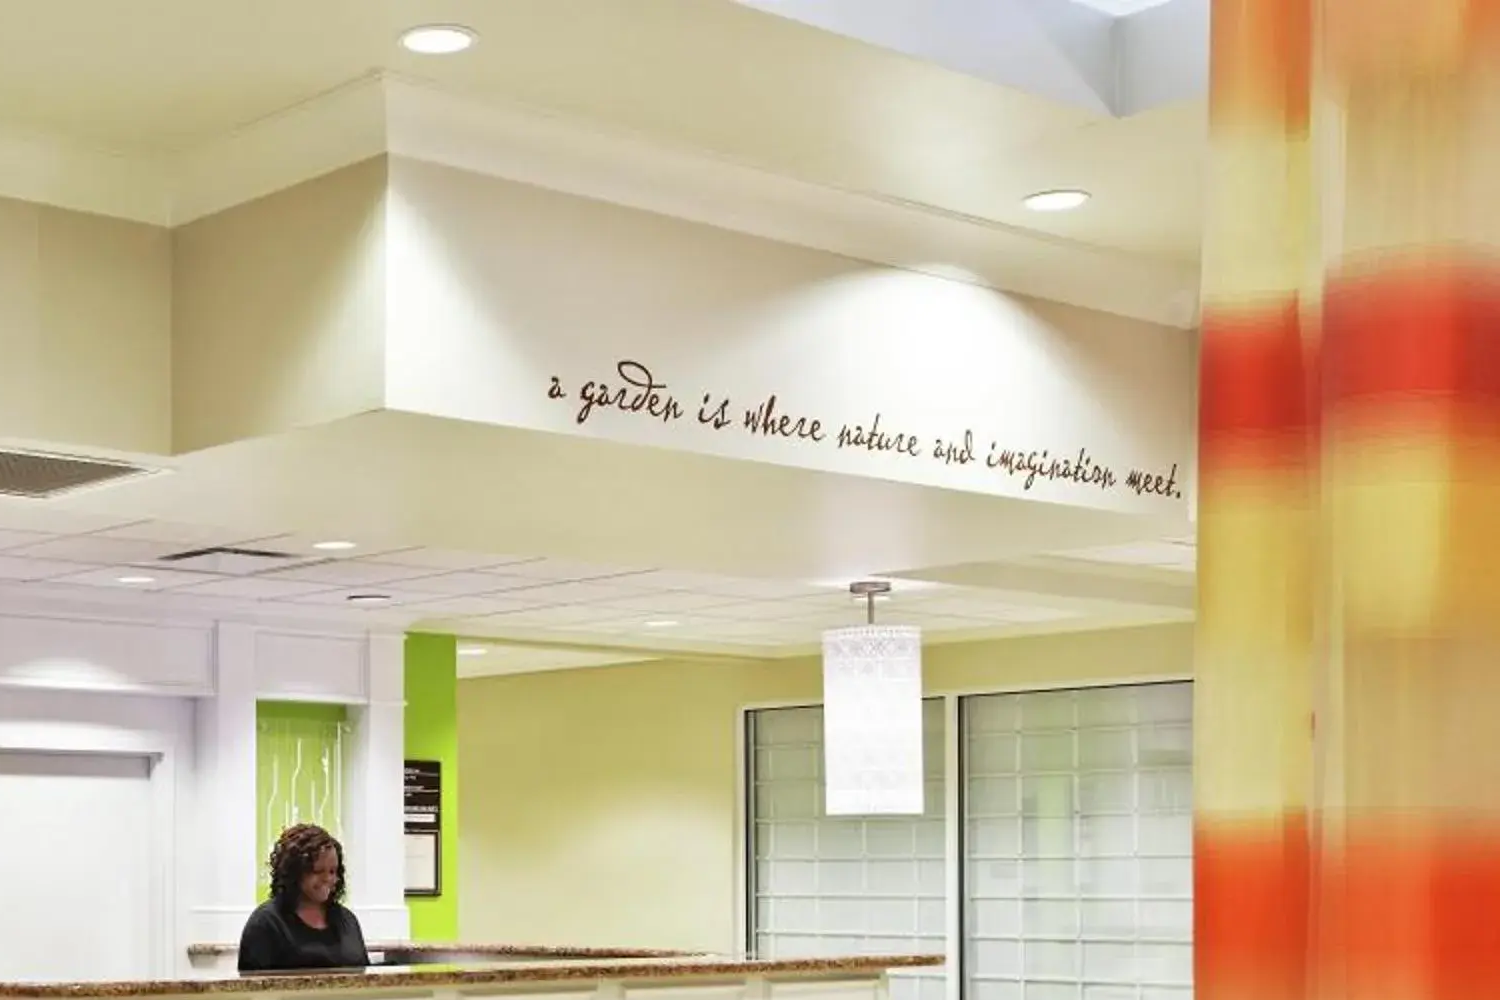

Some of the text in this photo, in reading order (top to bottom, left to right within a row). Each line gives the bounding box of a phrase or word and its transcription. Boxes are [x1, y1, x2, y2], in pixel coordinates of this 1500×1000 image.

[547, 360, 1182, 499] a garden is where nature and imagination meet.
